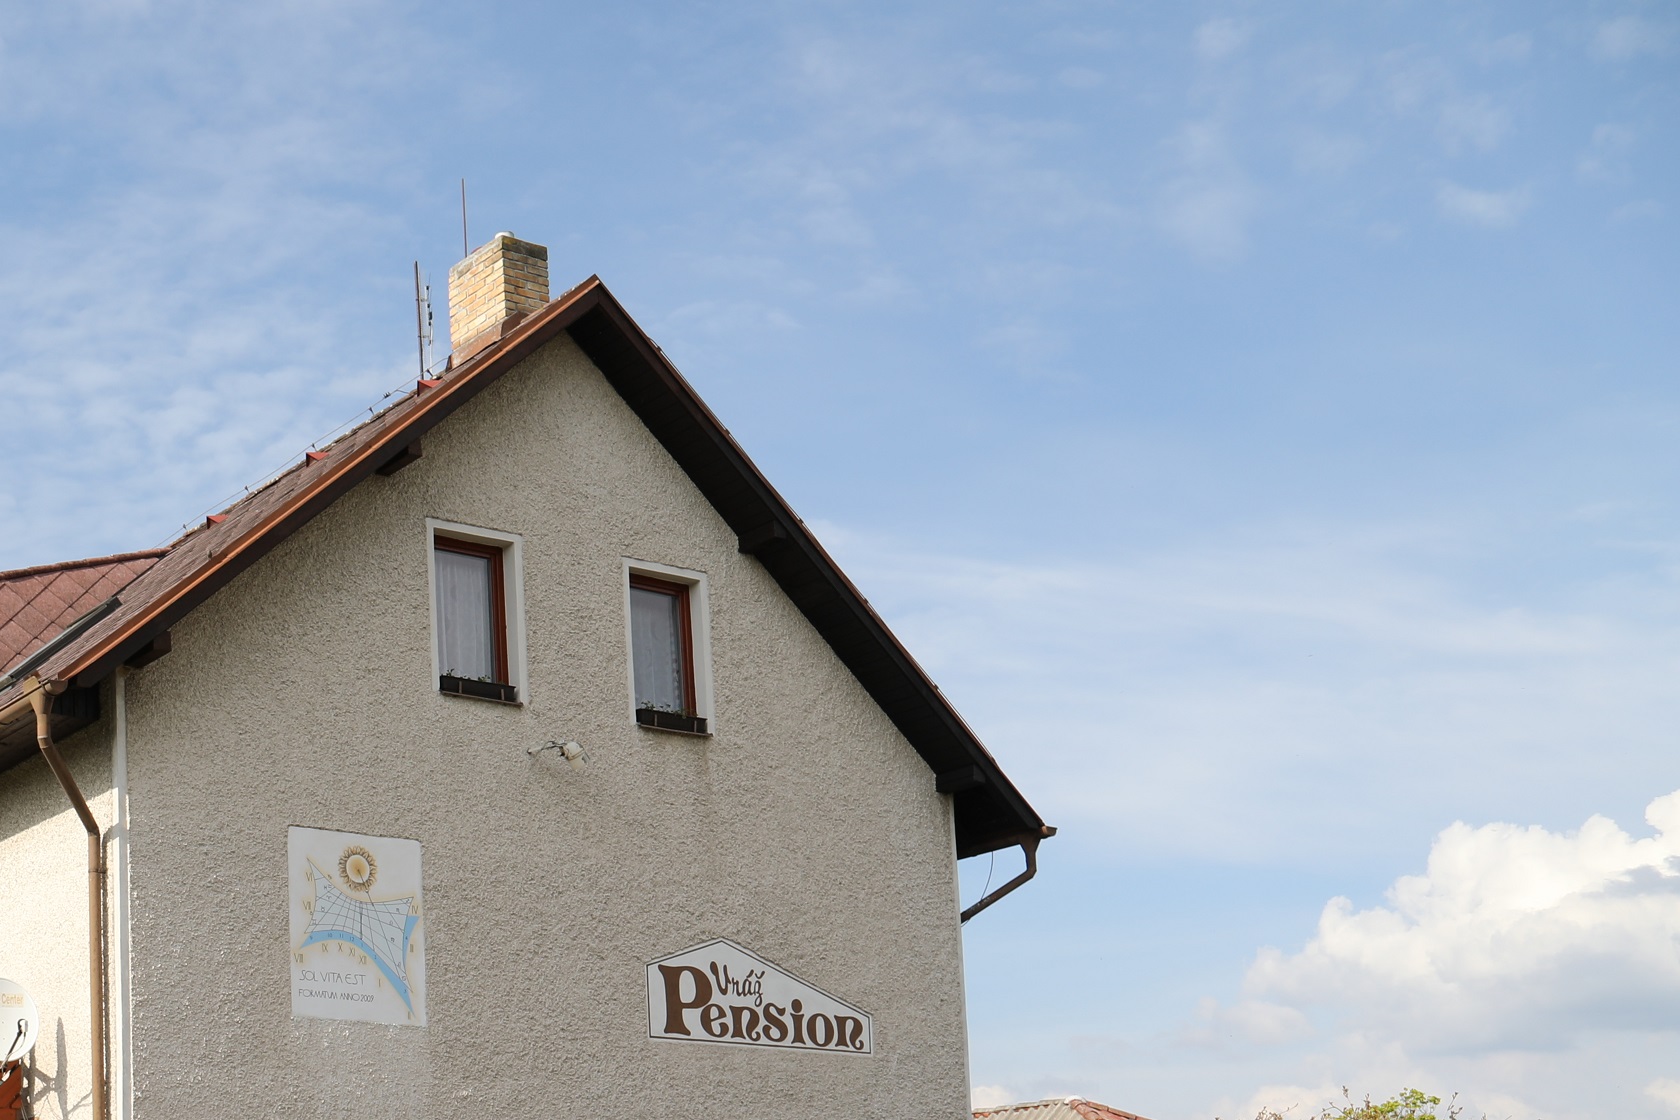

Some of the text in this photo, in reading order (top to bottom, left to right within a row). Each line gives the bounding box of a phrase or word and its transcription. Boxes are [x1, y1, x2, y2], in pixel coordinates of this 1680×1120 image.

[299, 970, 366, 985] SOL VITA EST
[657, 963, 865, 1051] Pension
